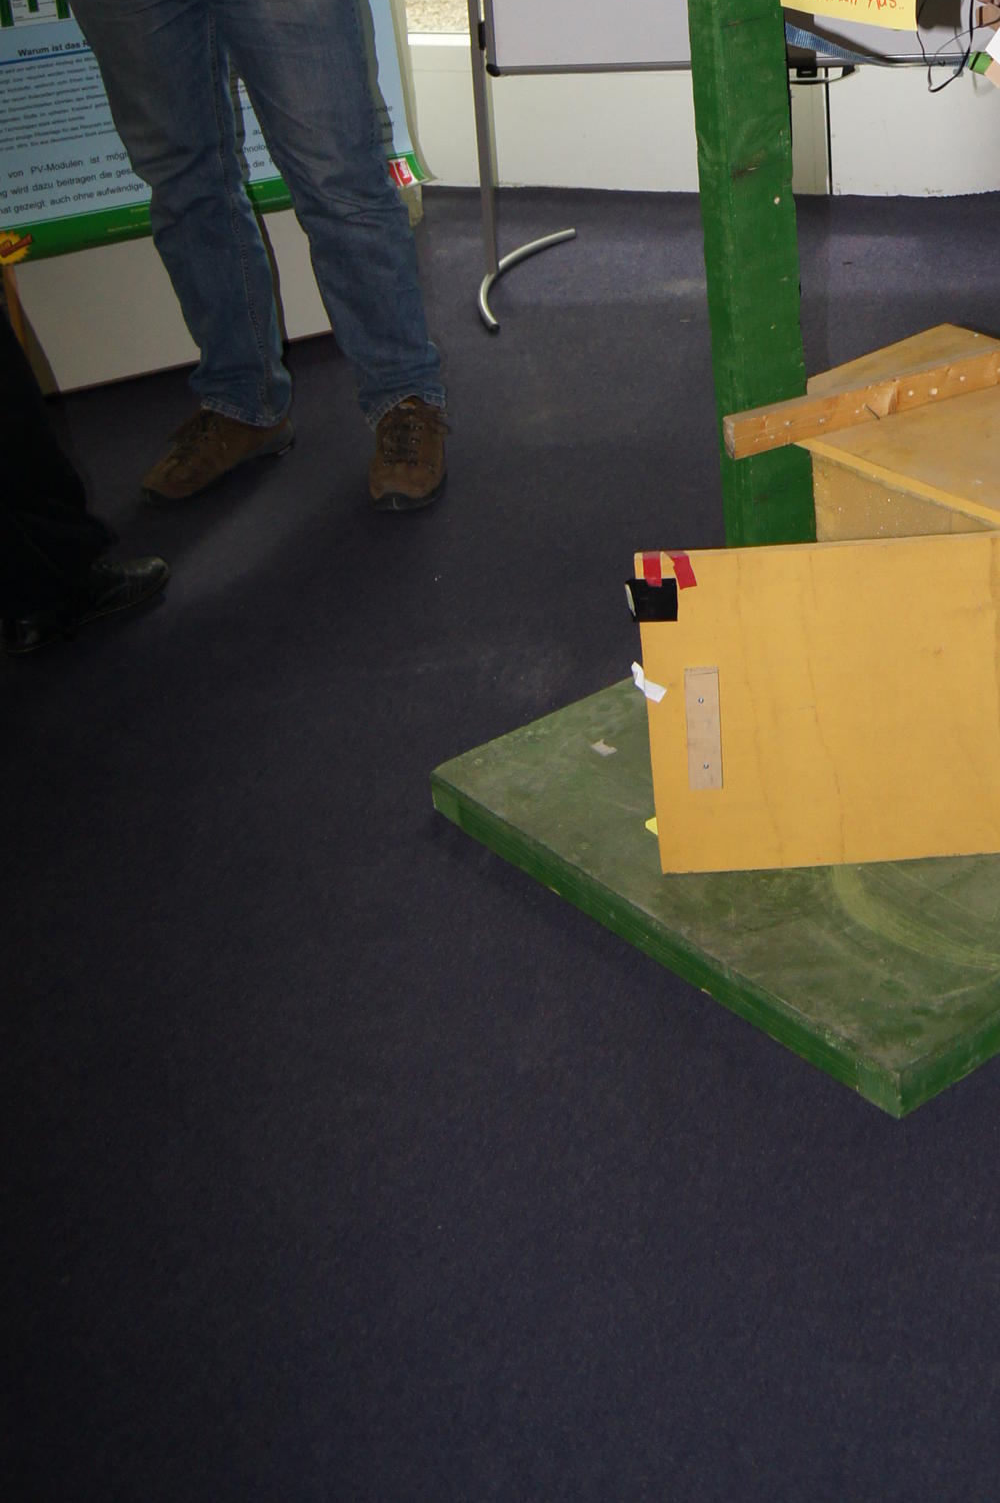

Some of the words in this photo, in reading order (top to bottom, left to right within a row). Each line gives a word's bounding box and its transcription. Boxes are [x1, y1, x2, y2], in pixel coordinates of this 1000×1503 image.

[17, 46, 50, 58] Warum
[51, 43, 63, 52] ist
[64, 41, 81, 50] das
[7, 168, 24, 179] von
[30, 159, 84, 175] PV-Modulen
[89, 155, 100, 164] ist
[10, 184, 30, 195] wird
[32, 180, 55, 192] dazu
[56, 173, 97, 188] beitragen
[99, 169, 113, 180] die
[50, 194, 71, 206] auch
[73, 191, 95, 202] ohne
[96, 182, 145, 198] aufwändige
